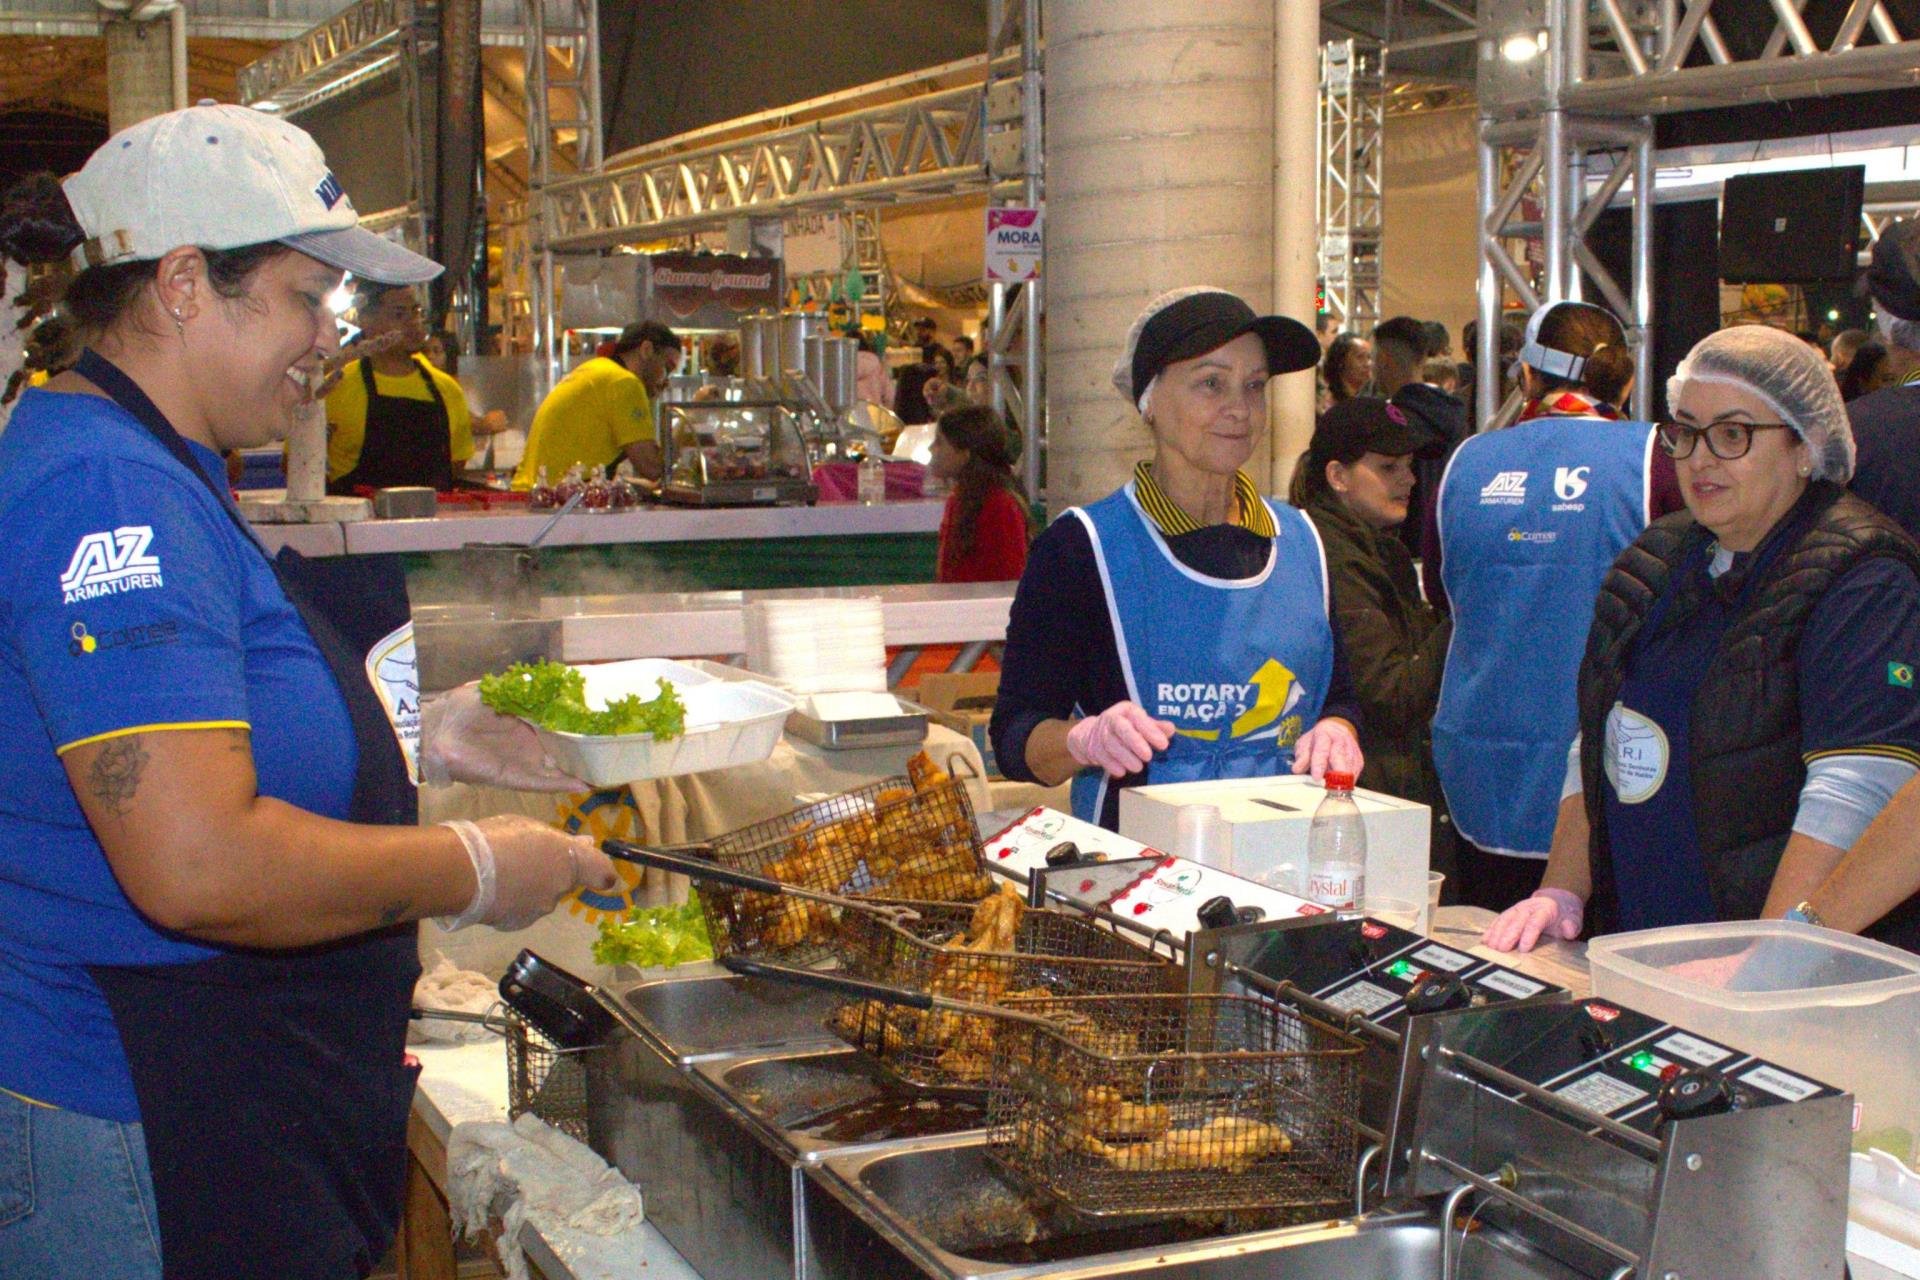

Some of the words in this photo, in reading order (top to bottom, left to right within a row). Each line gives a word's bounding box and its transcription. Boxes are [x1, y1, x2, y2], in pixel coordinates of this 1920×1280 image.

[64, 574, 163, 605] ARMATUREN
[1157, 683, 1251, 702] ROTARY
[1158, 704, 1181, 717] EM
[1309, 878, 1347, 898] rystal
